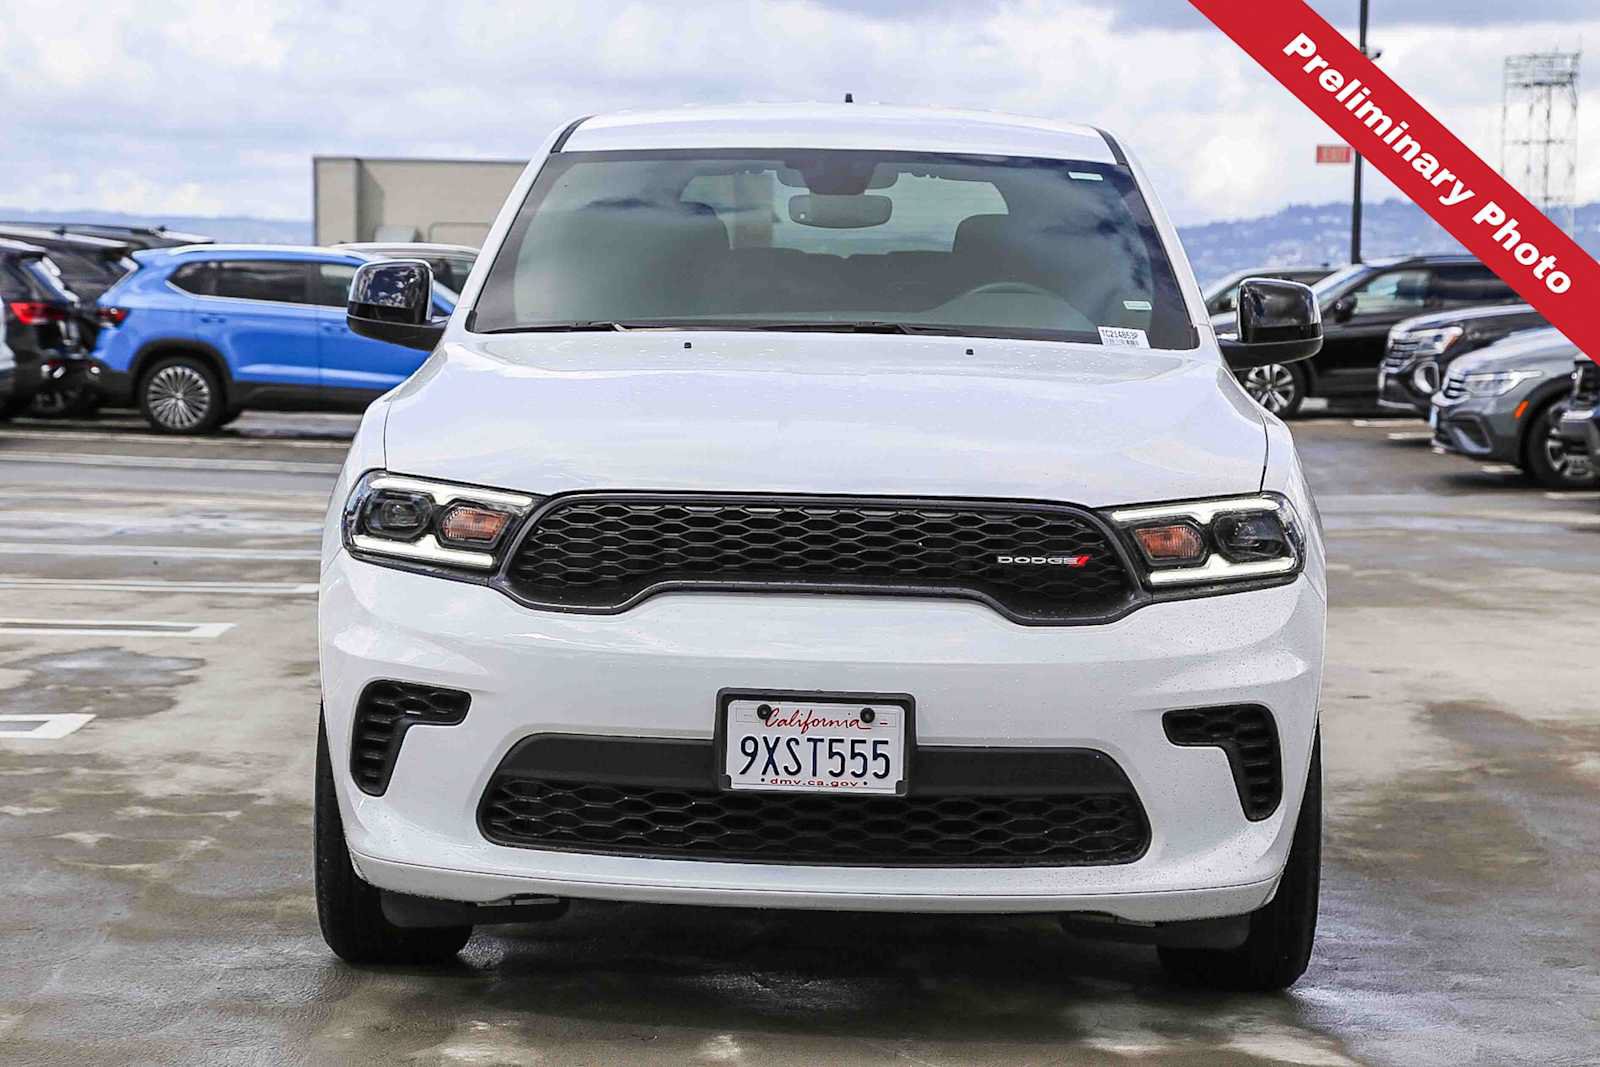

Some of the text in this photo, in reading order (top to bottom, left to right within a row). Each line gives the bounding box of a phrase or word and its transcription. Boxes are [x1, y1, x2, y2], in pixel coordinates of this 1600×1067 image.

[997, 556, 1078, 565] DODGE
[764, 707, 871, 734] California
[739, 736, 891, 779] 9XST555
[769, 777, 858, 788] dmv.ca.gov
